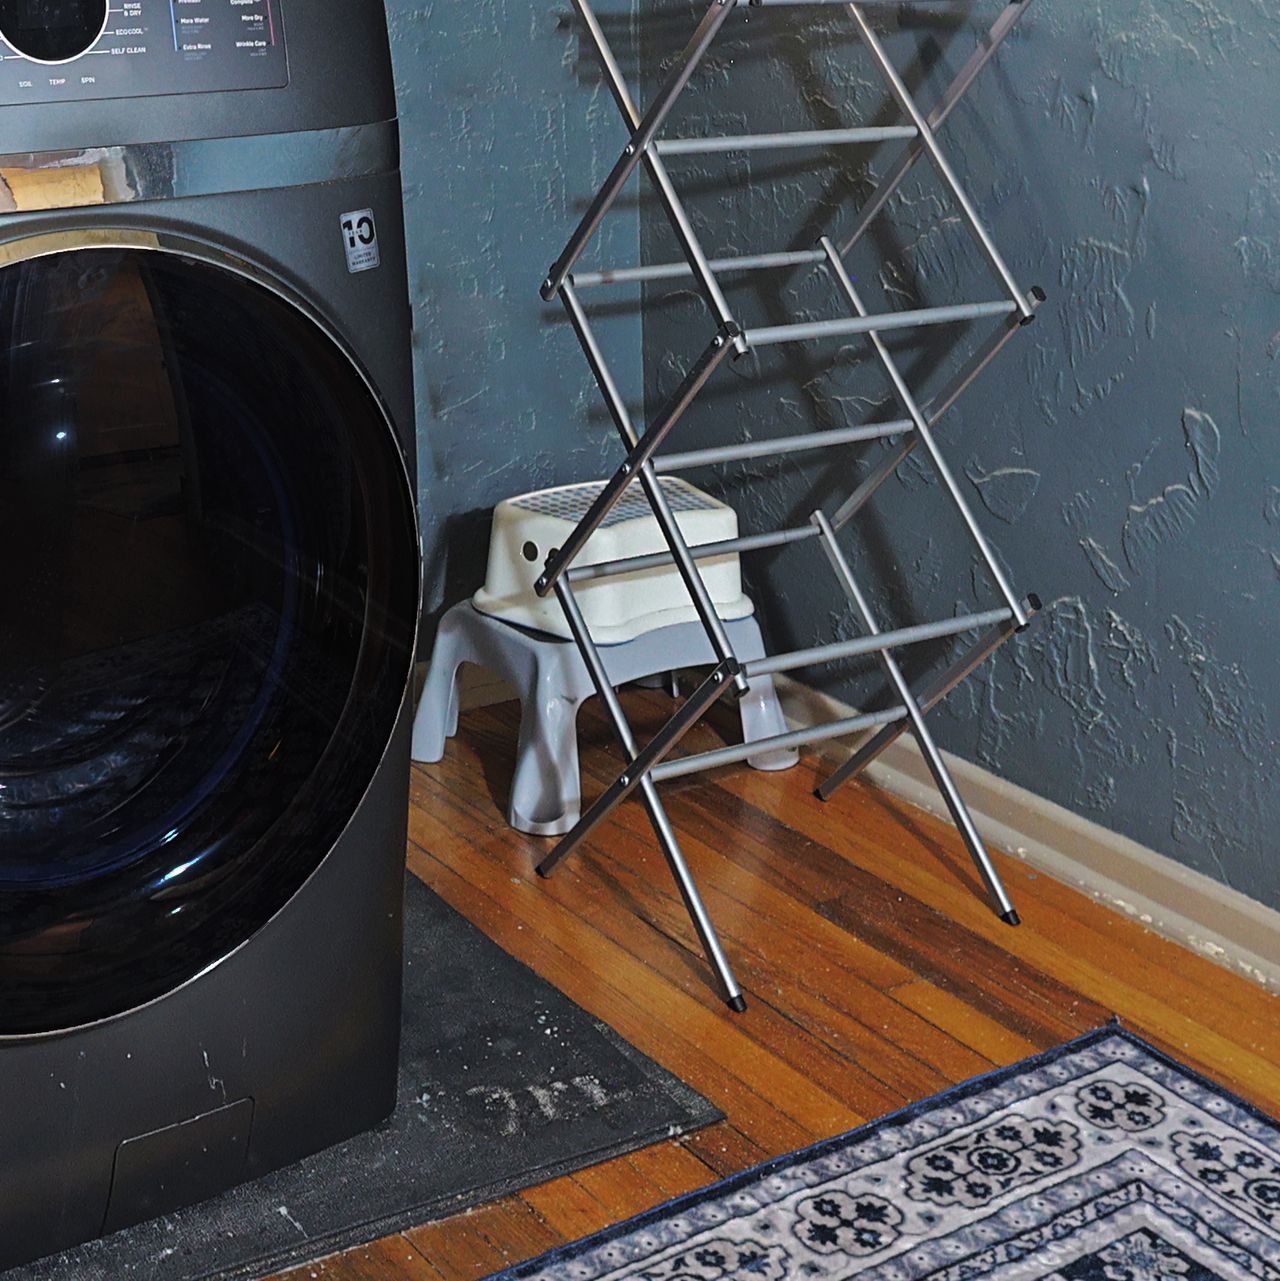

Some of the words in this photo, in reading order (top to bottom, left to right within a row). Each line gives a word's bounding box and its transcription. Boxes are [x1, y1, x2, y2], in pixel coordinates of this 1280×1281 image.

[49, 78, 66, 86] TEMP
[80, 76, 96, 84] SPIN
[342, 216, 375, 249] 10
